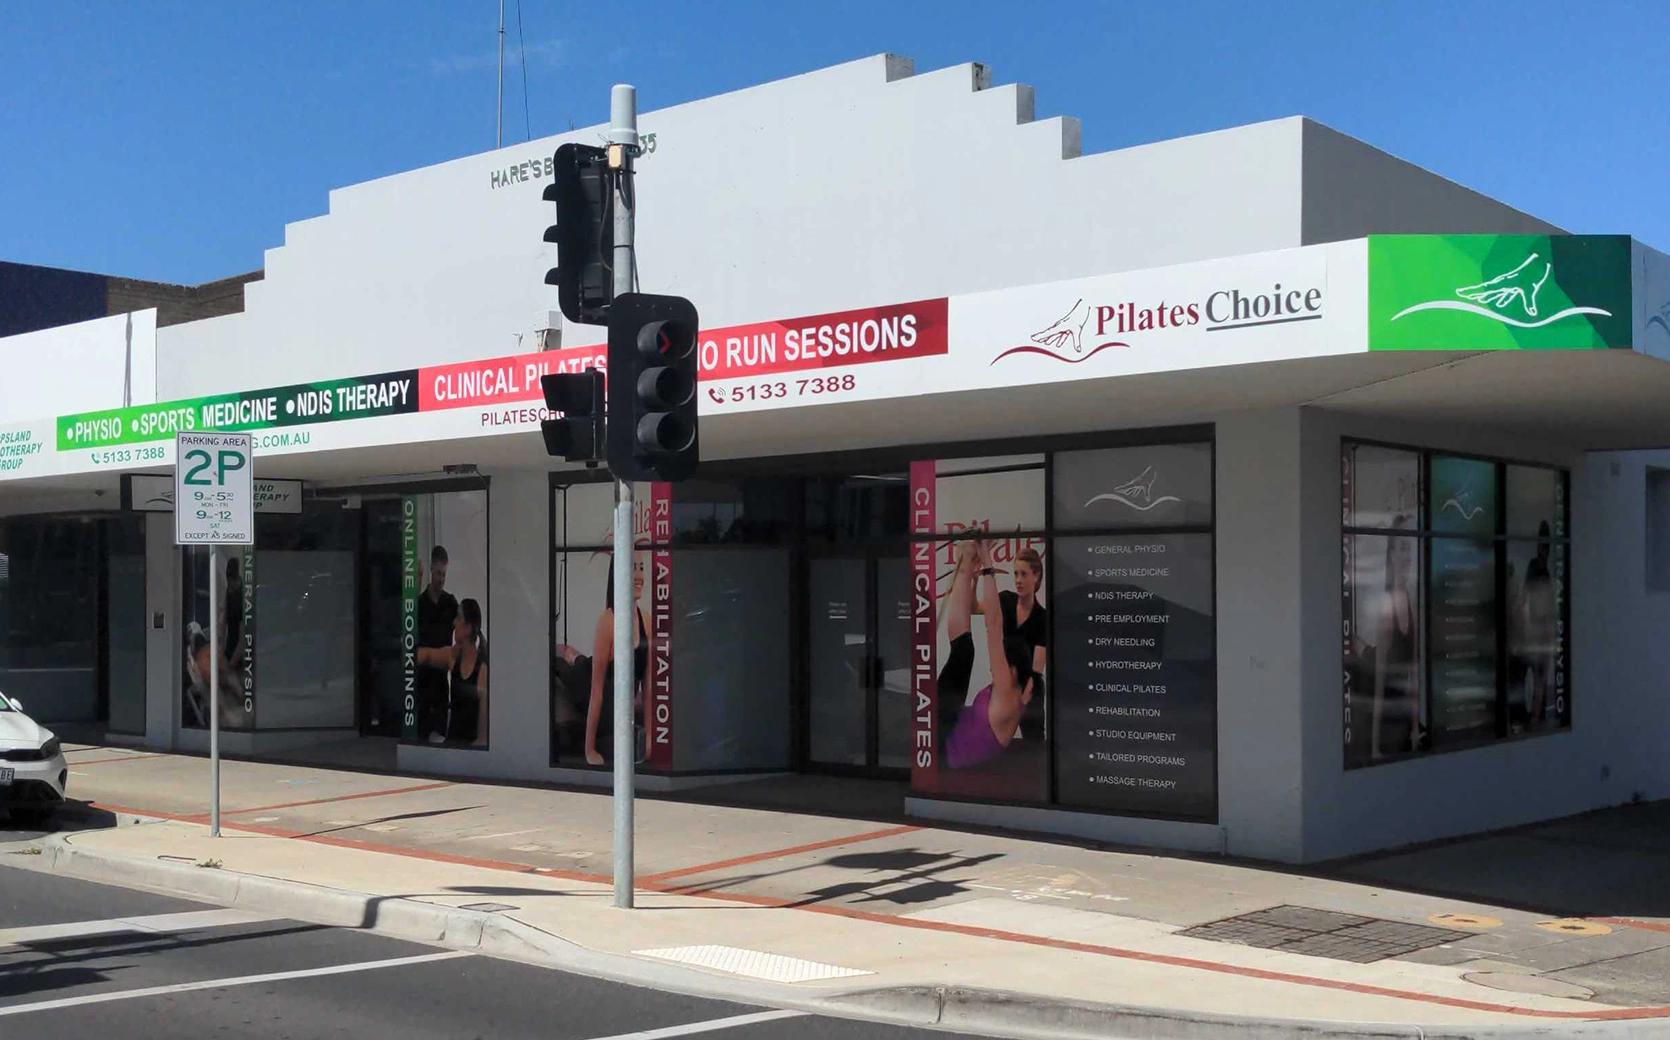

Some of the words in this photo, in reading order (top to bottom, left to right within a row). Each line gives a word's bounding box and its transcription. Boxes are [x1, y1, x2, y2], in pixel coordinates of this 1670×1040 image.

[490, 159, 542, 189] HARE'S
[639, 133, 657, 154] 35
[1095, 300, 1200, 336] Pilates
[1205, 283, 1322, 323] Choice
[434, 367, 520, 401] CLINICAL
[726, 332, 777, 368] RUN
[784, 314, 917, 361] SESSIONS
[731, 382, 787, 402] 5133
[796, 374, 856, 396] 7388
[75, 416, 122, 443] PHYSIO
[141, 407, 195, 435] SPORTS
[202, 396, 277, 428] MEDICINE
[297, 389, 333, 418] NDIS
[337, 379, 411, 412] THERAPY
[0, 430, 32, 444] PSLAND
[181, 437, 220, 446] PARKING
[222, 438, 248, 447] AREA
[252, 431, 310, 449] G.COM.AU
[0, 441, 43, 457] OTHERAPY
[103, 450, 132, 464] 5133
[135, 446, 165, 461] 7388
[183, 449, 246, 486] 2P
[219, 511, 232, 520] 12
[185, 532, 209, 540] EXCEPT
[222, 532, 246, 540] SIGNED
[404, 500, 415, 589] ONLINE
[1094, 546, 1133, 554] GENERAL
[1135, 544, 1167, 553] PHYSIO
[914, 487, 931, 633] CLINICAL
[1094, 569, 1128, 577] SPORTS
[1129, 568, 1169, 576] MEDICINE
[1095, 592, 1115, 600] NDIS
[1116, 591, 1154, 600] THERAPY
[655, 498, 670, 744] REHABILITATION
[1095, 615, 1112, 623] PRE
[1113, 615, 1170, 623] EMPLOYMENT
[1095, 638, 1112, 646] DRY
[1114, 638, 1156, 647] NEEDLING
[404, 601, 415, 727] BOOKINGS
[1095, 661, 1162, 670] HYDROTHERAPY
[244, 634, 253, 713] PHYSIO
[1095, 684, 1132, 693] CLINICAL
[1133, 685, 1167, 694] PILATES
[915, 645, 932, 769] PILATES
[1095, 706, 1161, 717] REHABILITATION
[1096, 729, 1126, 739] STUDIO
[1128, 731, 1176, 741] EQUIPMENT
[1096, 752, 1136, 763] TAILORED
[1137, 755, 1186, 766] PROGRAMS
[1096, 775, 1136, 786] MASSAGE
[1138, 778, 1177, 789] THERAPY
